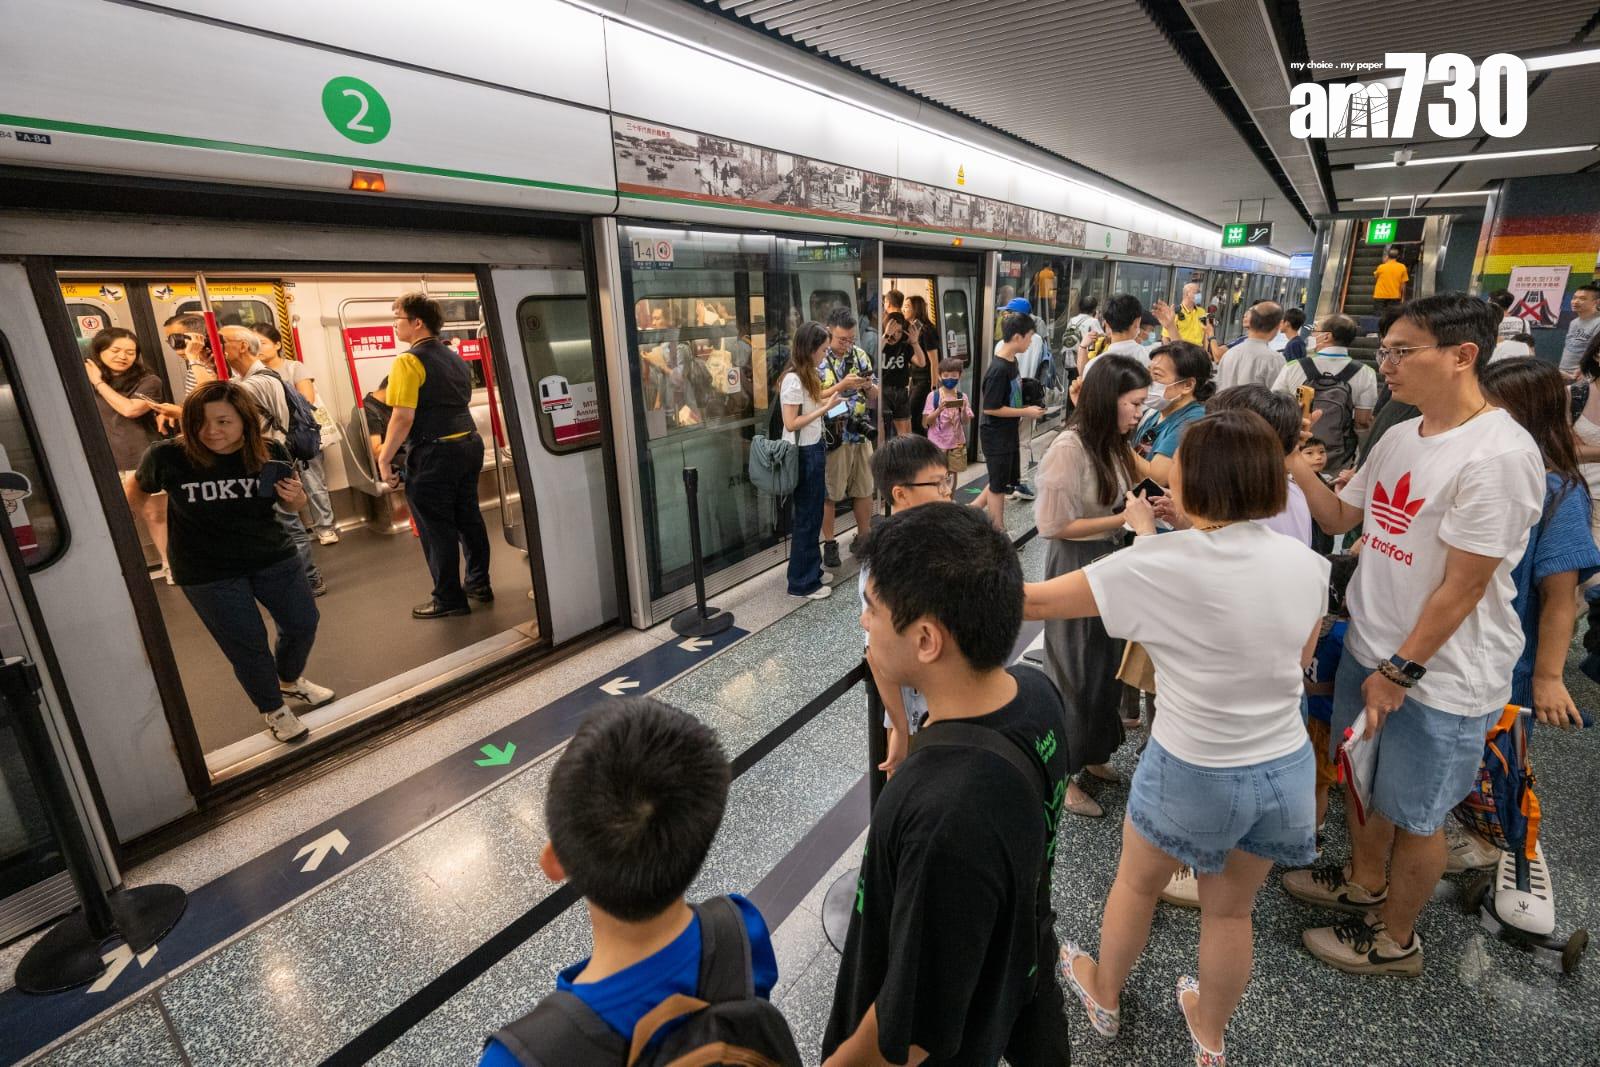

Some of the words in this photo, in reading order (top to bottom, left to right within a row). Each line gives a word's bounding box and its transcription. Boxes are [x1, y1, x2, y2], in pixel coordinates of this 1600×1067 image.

[342, 88, 374, 133] 2
[634, 241, 652, 259] 1-4
[181, 478, 260, 503] TOKY
